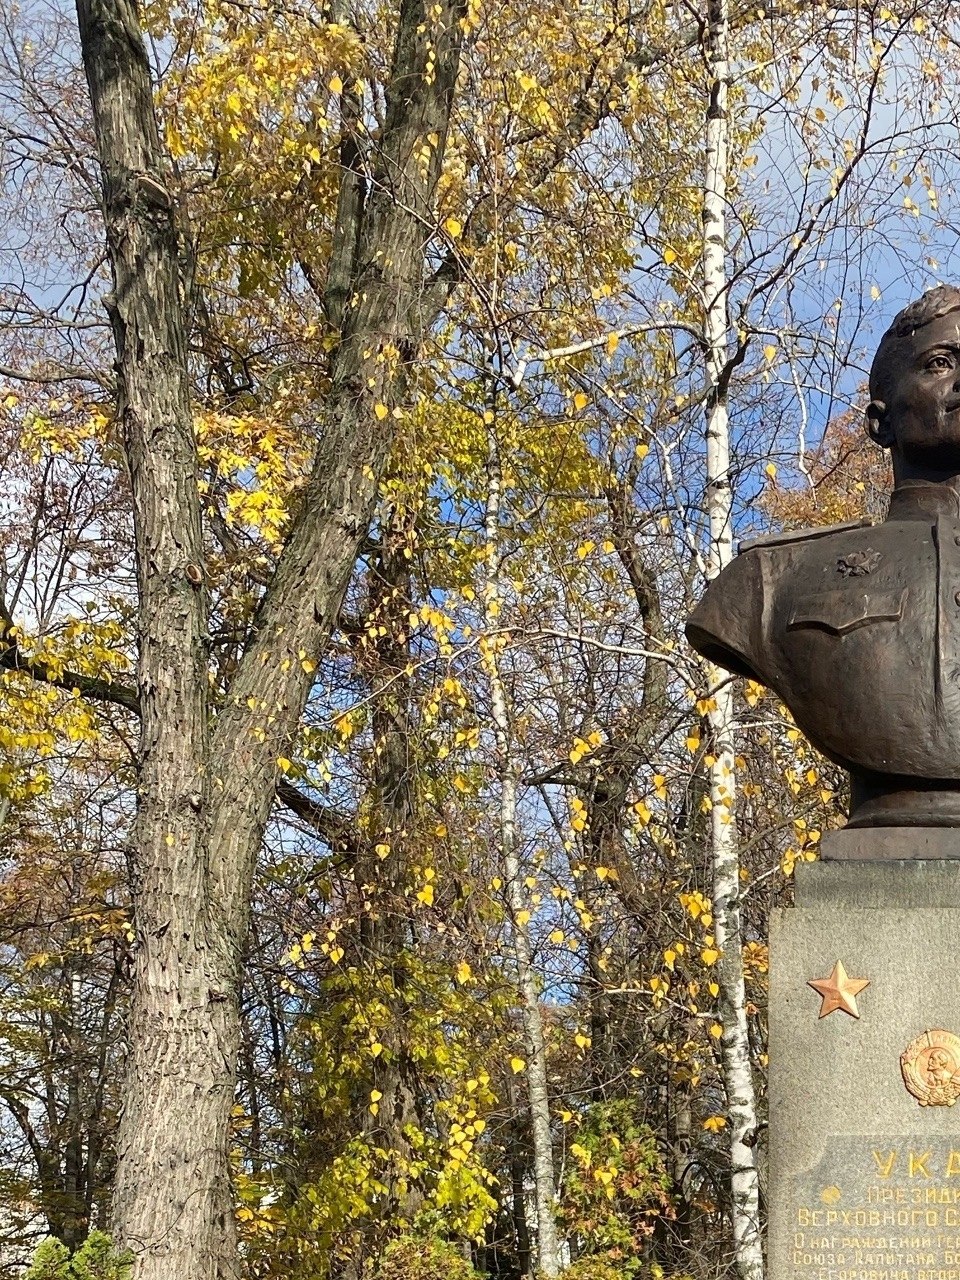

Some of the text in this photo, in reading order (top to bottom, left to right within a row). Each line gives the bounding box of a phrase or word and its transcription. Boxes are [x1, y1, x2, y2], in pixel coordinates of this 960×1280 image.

[798, 1210, 937, 1226] ВЕРХОВНОГО
[794, 1233, 805, 1249] О
[810, 1238, 931, 1249] НАГРАЖДЕНИИ
[793, 1250, 846, 1265] СОЮЗА
[854, 1250, 935, 1265] КАПИТАНА
[819, 1268, 909, 1280] ЕГОРОВИЧА
